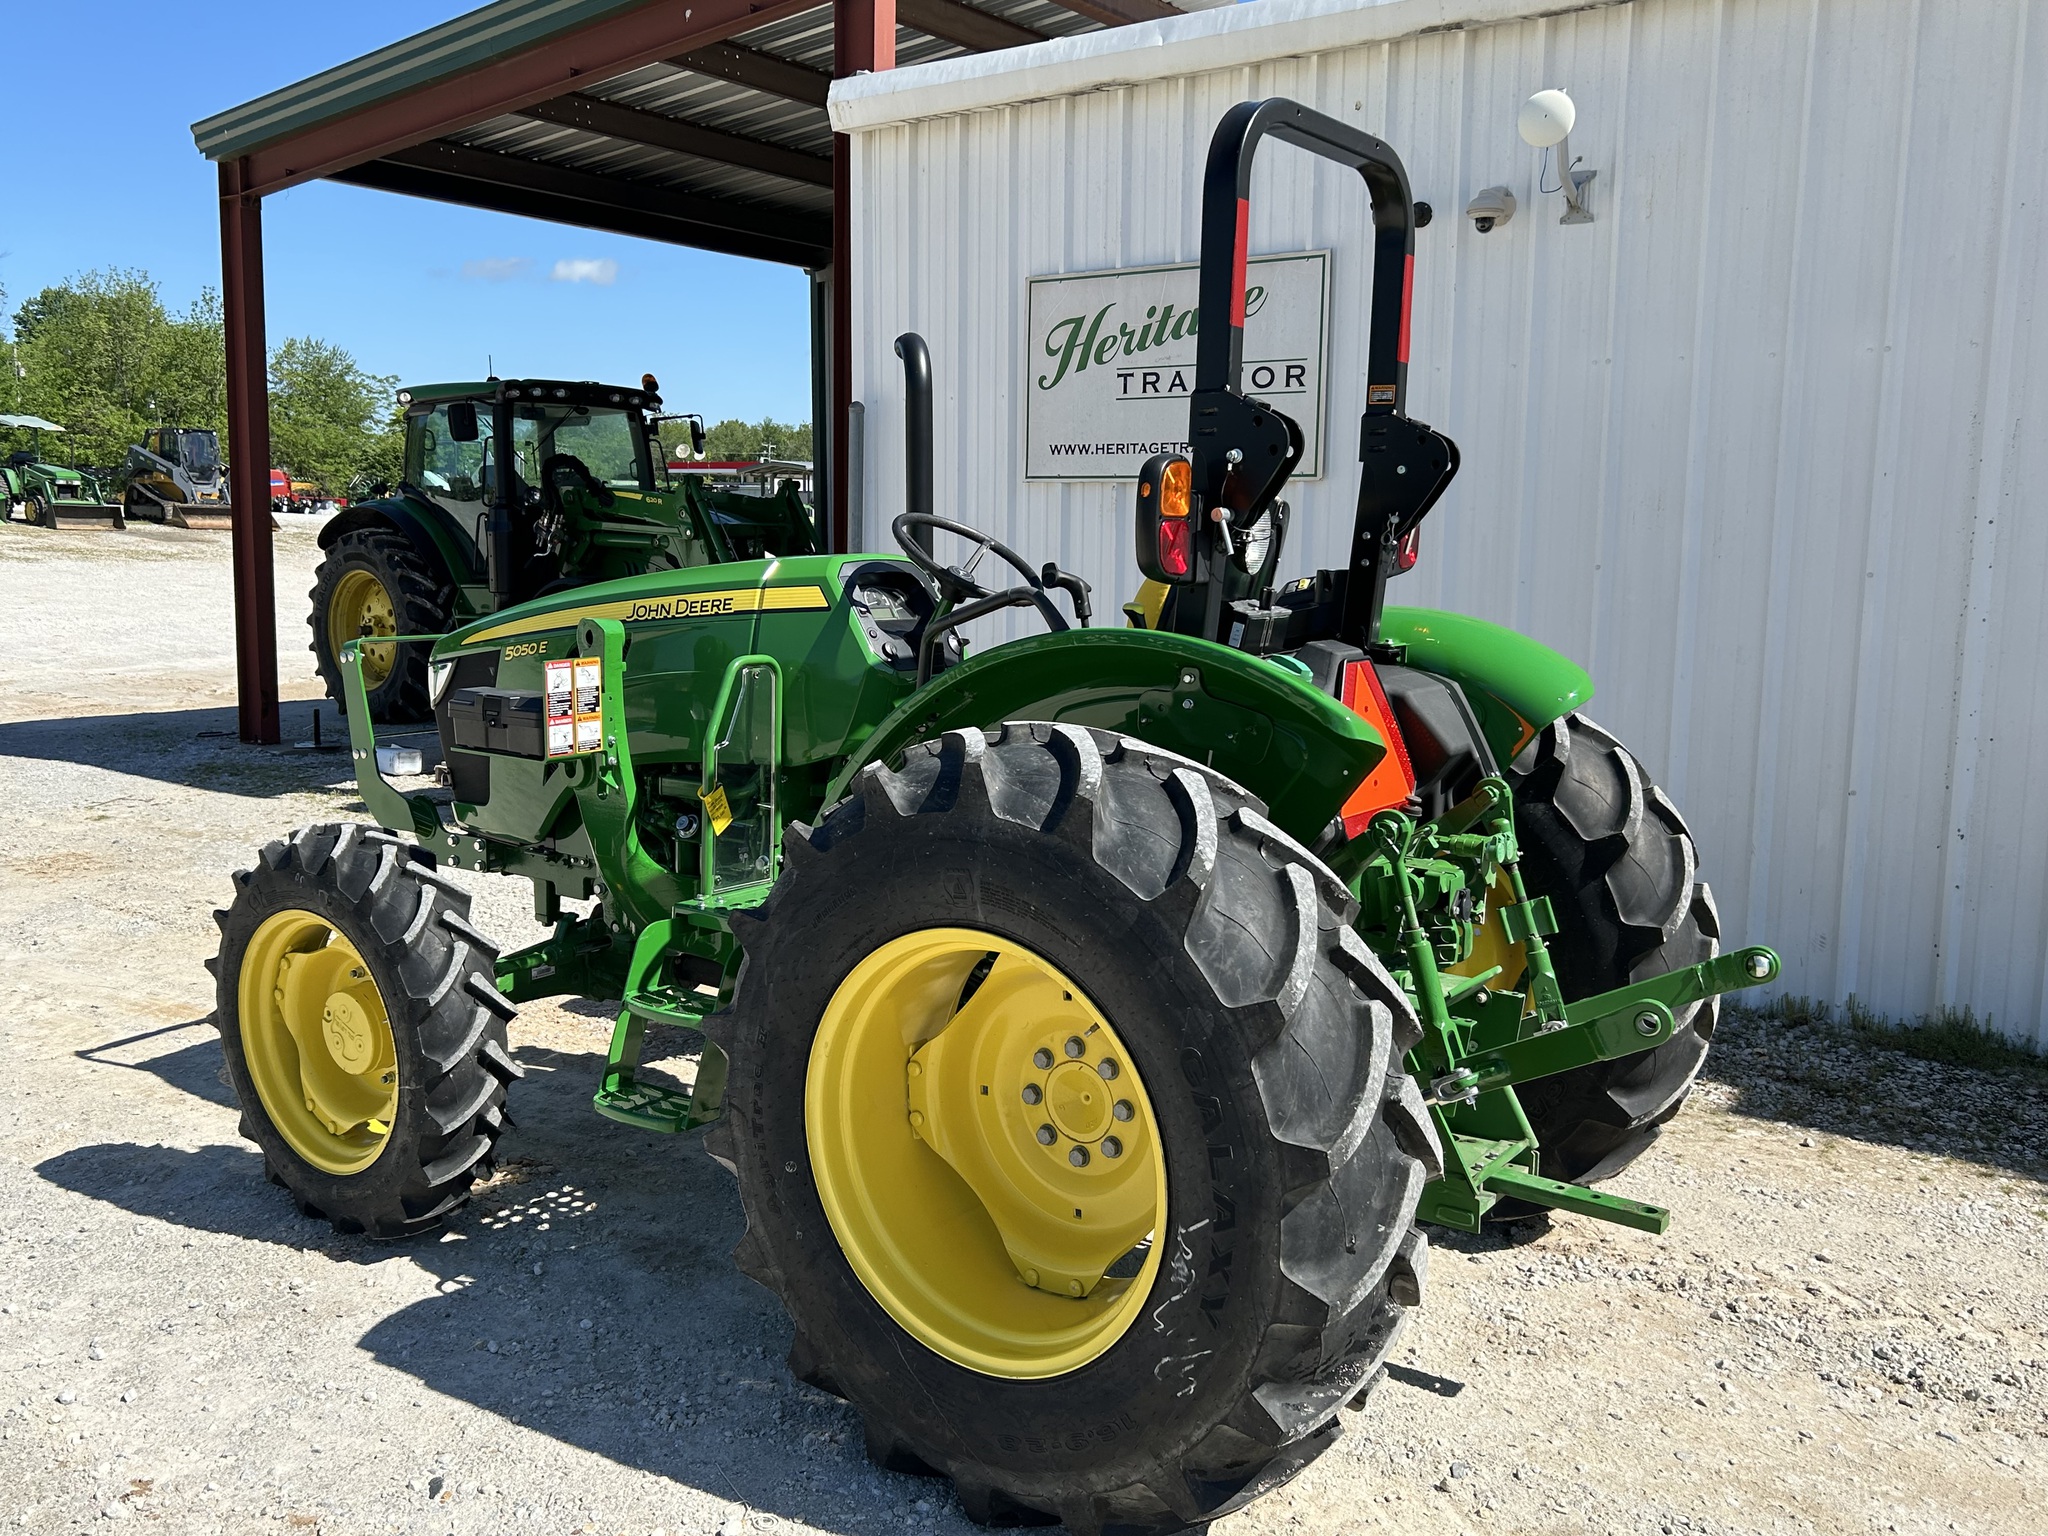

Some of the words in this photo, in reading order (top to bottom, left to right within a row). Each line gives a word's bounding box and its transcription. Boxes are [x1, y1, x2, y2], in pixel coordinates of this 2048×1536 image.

[1037, 284, 1269, 390] Heritae
[1117, 364, 1306, 395] TRAOR
[1049, 442, 1194, 456] WWW.HERITAGETR
[625, 602, 672, 619] JOHN
[675, 597, 734, 615] DEERE
[1180, 1046, 1239, 1331] GALAXY
